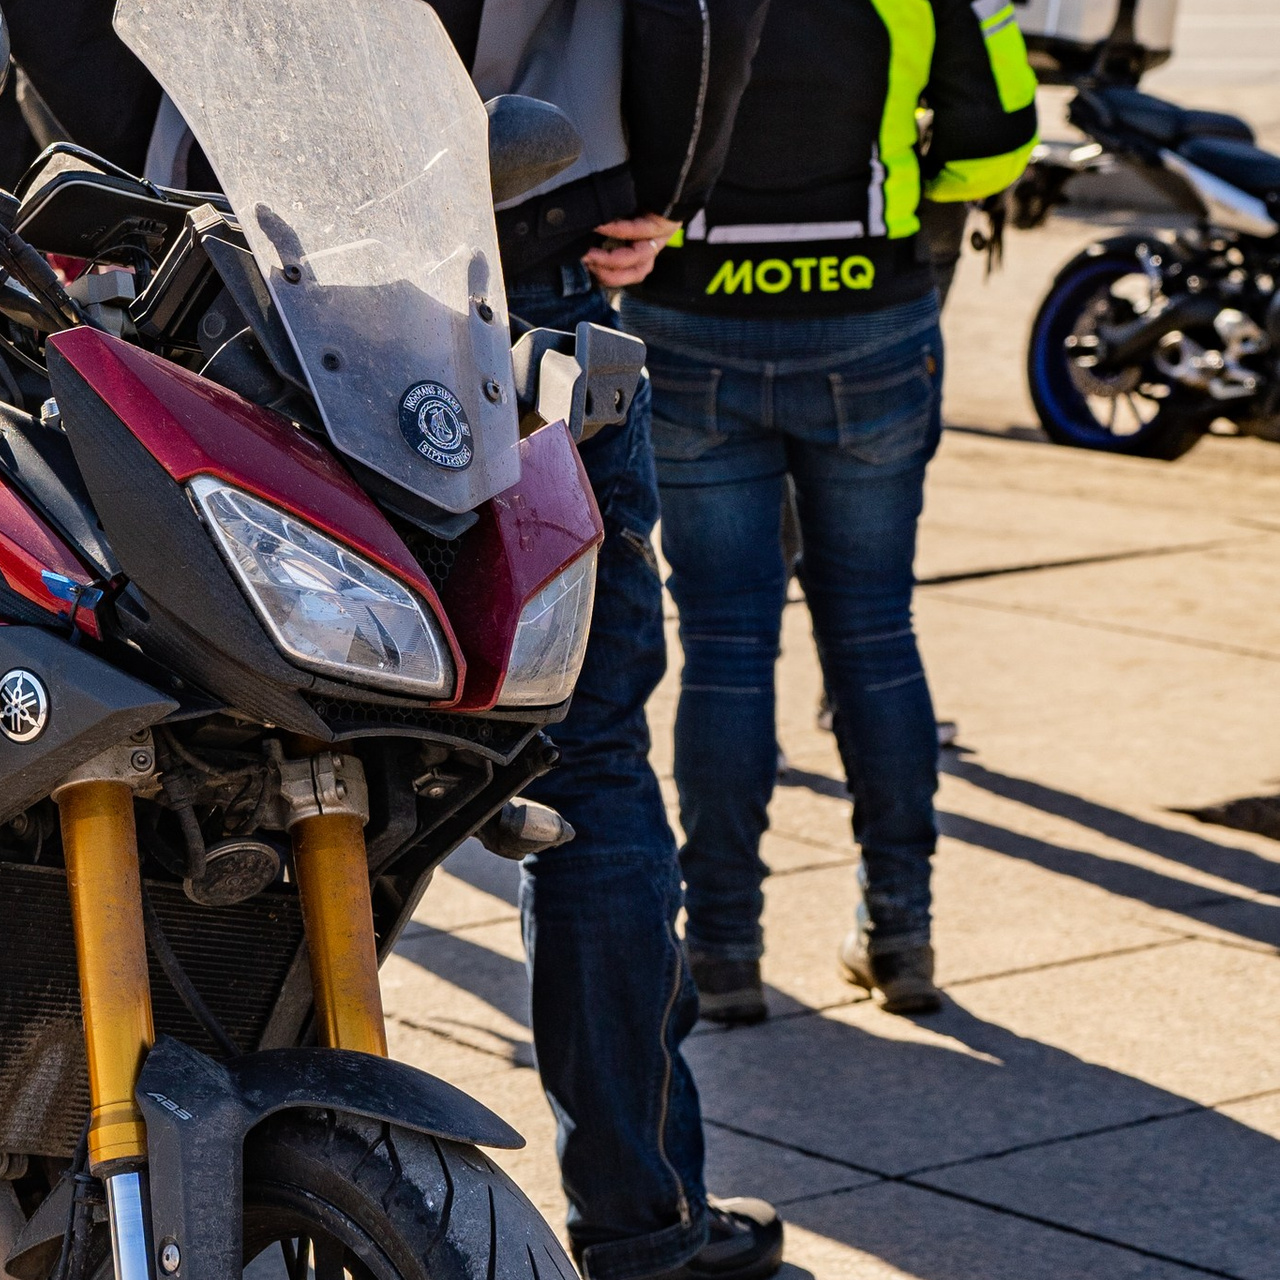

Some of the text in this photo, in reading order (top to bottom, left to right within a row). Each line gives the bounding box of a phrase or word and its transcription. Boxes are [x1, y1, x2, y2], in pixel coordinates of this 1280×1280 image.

[705, 255, 875, 295] MOTEQ
[405, 385, 436, 408] NORMANS
[147, 1092, 192, 1120] ABS
